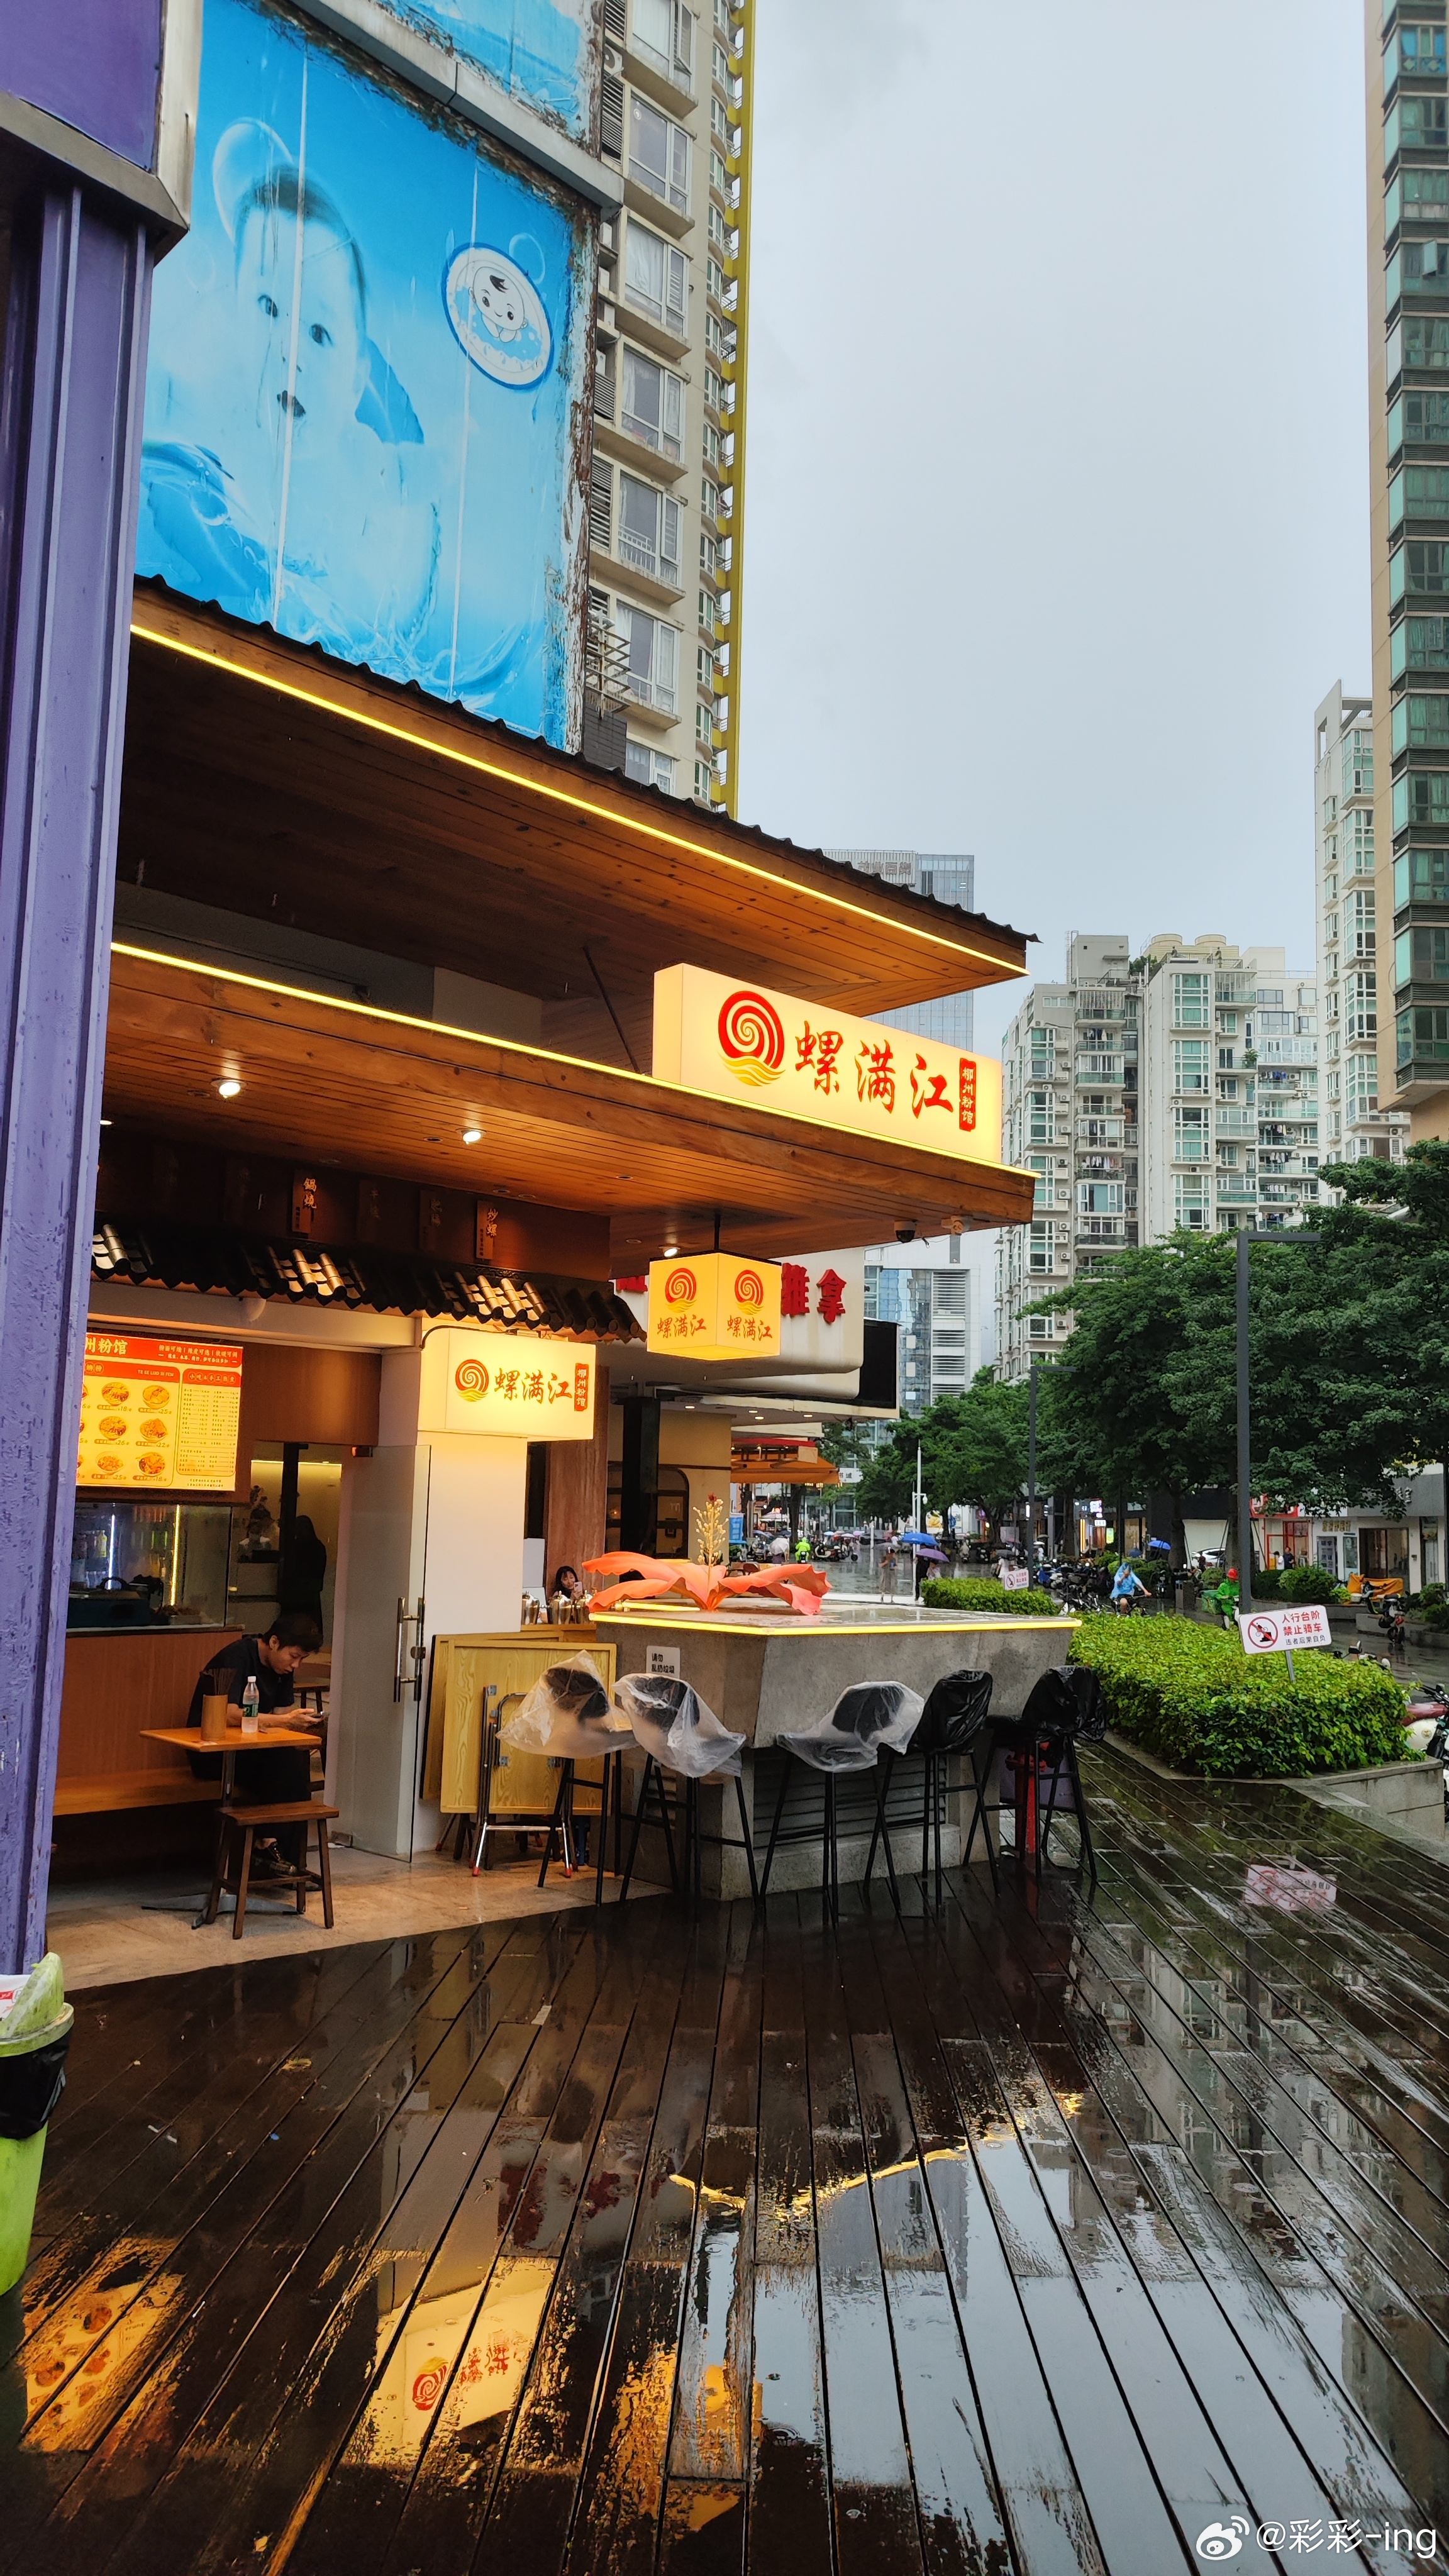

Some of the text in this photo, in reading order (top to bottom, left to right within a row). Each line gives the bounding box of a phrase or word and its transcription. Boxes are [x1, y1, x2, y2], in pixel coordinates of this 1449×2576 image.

[796, 1021, 953, 1119] 螺满江
[961, 1068, 974, 1125] 柳州粉馆
[487, 1208, 499, 1237] 炒螺
[782, 1262, 847, 1323] 推拿
[657, 1314, 706, 1339] 螺满江
[726, 1315, 773, 1341] 螺满江
[494, 1367, 572, 1404] 螺满江
[575, 1368, 587, 1407] 柳州粉馆
[1282, 1611, 1320, 1624] 人行台阶
[1283, 1623, 1323, 1636] 禁止骑车
[1285, 1635, 1326, 1645] 违者后果自负
[652, 1653, 663, 1662] 请勿
[652, 1664, 675, 1674] 乱扔垃圾
